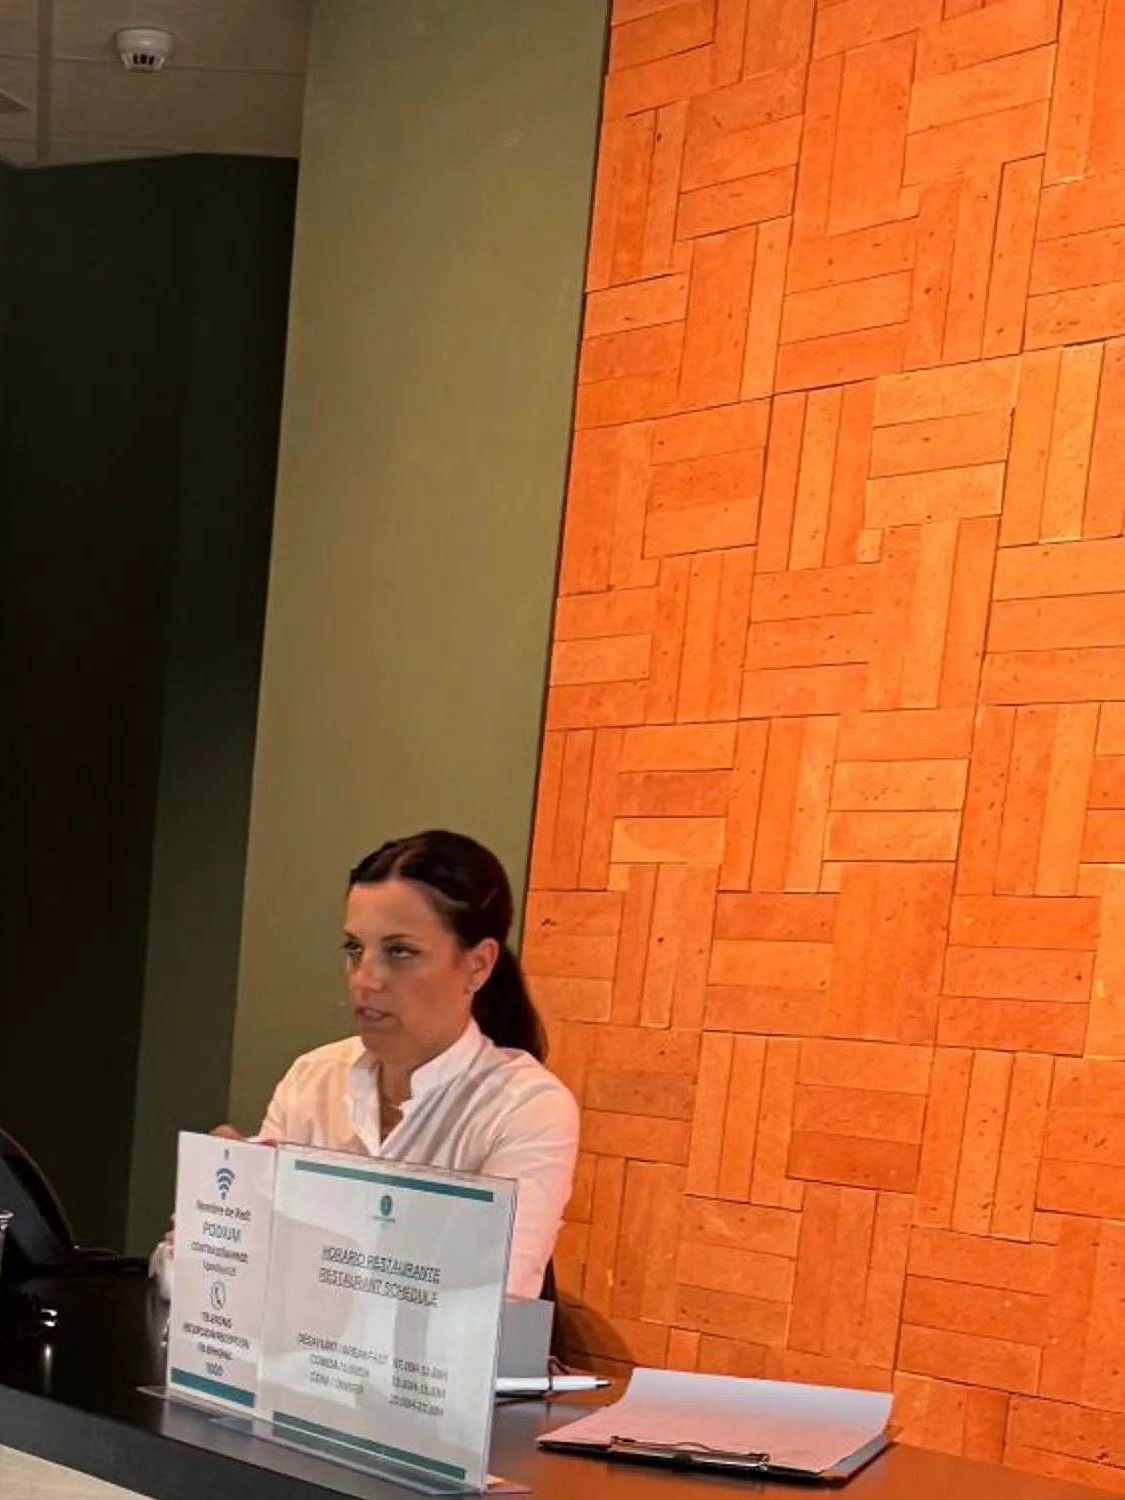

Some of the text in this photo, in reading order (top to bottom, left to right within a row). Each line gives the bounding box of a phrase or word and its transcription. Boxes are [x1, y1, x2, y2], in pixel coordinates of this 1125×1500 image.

[202, 1221, 242, 1242] PODIUM
[321, 1245, 441, 1284] HORARIO RESTAURANTE
[317, 1266, 439, 1308] RESTAURANT SCHEDULE
